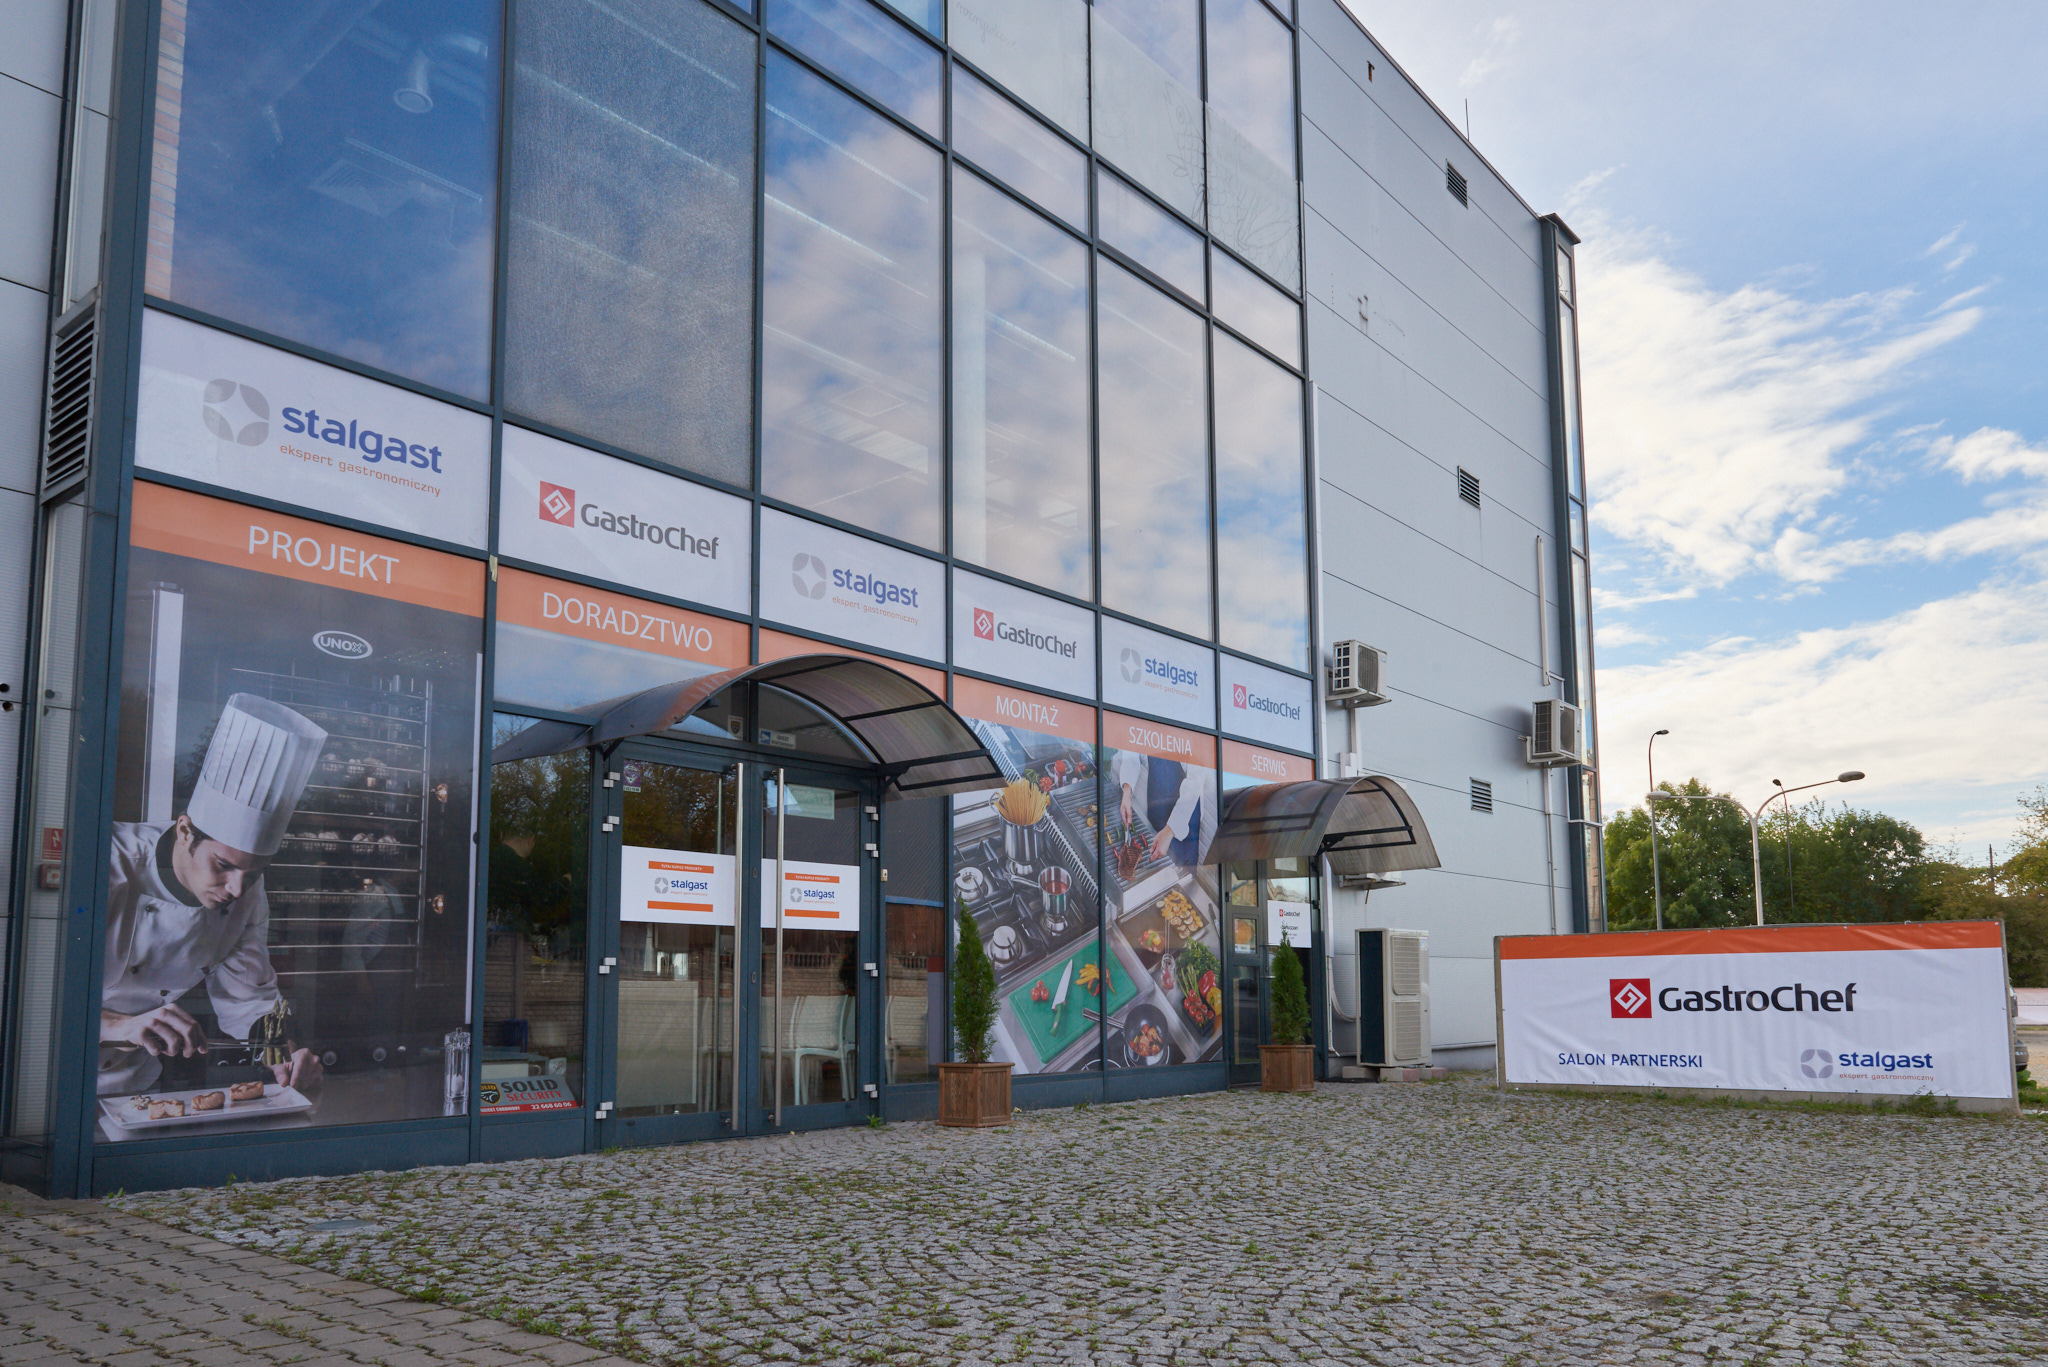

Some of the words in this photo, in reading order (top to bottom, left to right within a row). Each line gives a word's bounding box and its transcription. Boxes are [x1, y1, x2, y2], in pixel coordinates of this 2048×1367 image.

[281, 406, 443, 475] stalgast
[279, 444, 333, 467] ekspert
[338, 459, 442, 498] gastronomiczny
[580, 503, 720, 560] GastroChef
[248, 525, 400, 584] PROJEKT
[832, 568, 919, 608] stalgast
[542, 591, 713, 652] DORADZTWO
[832, 595, 861, 610] ekspert
[863, 603, 919, 626] gastronomiczny
[319, 635, 363, 654] UNOX
[996, 621, 1078, 659] GastroChef
[1144, 657, 1199, 687] stalgast
[996, 695, 1059, 728] MONTAŻ
[1248, 693, 1302, 721] GastroChef
[1128, 725, 1193, 757] SZKOLENIA
[1251, 754, 1287, 777] SERWIS
[670, 879, 708, 891] stalgast
[803, 889, 835, 900] stalgast
[1658, 982, 1858, 1012] GastroChef
[1558, 1052, 1606, 1066] SALON
[1611, 1053, 1703, 1068] PARTNERSKI
[1838, 1051, 1934, 1072] stalgast
[501, 1079, 558, 1093] SOLID
[1871, 1073, 1934, 1082] gastronomiczny
[505, 1090, 562, 1102] SECURITY
